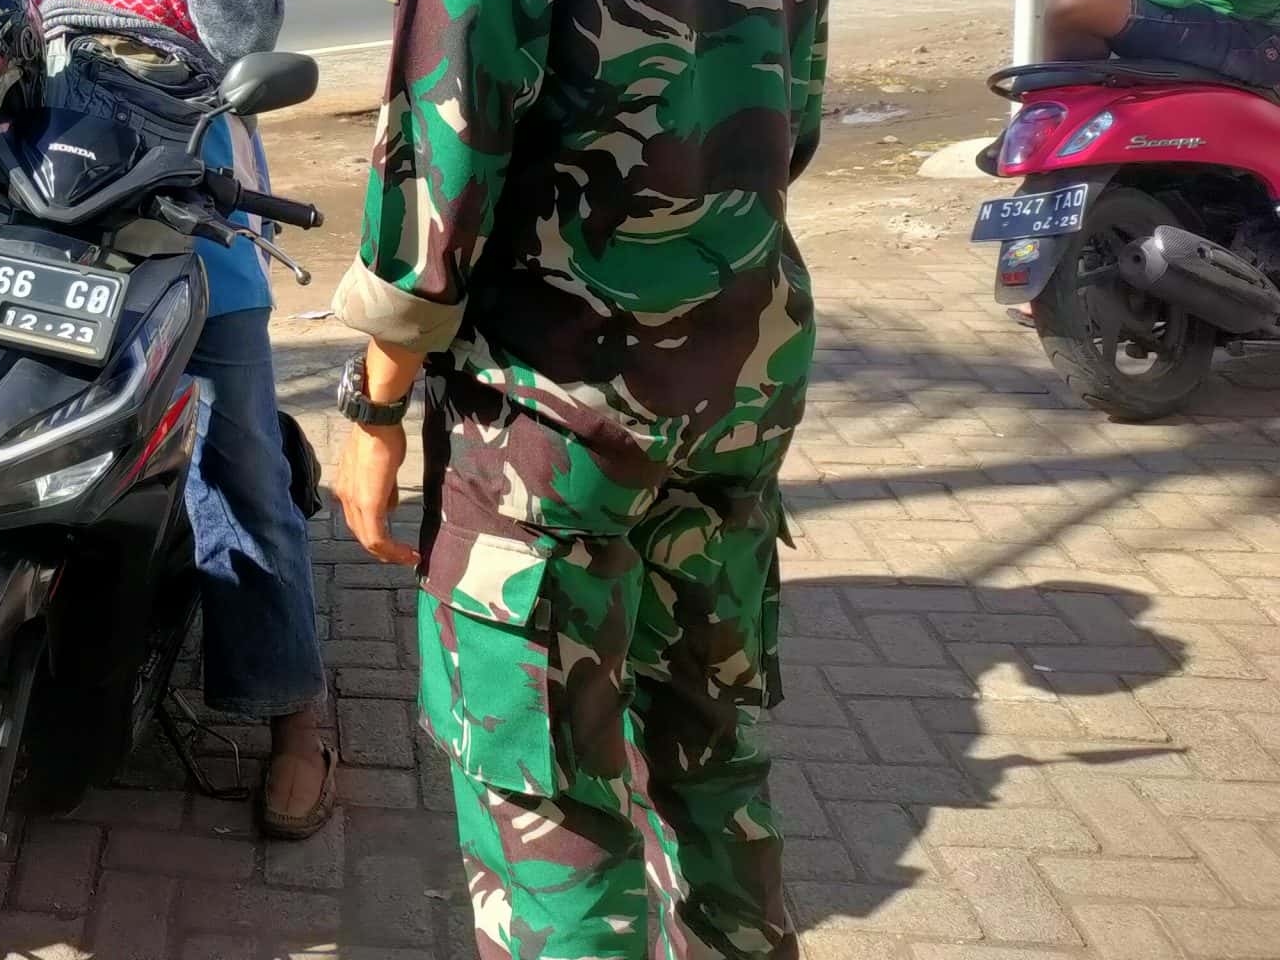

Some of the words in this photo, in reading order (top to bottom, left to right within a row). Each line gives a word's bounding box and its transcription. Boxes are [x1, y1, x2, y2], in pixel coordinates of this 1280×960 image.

[1124, 134, 1206, 149] Scoopy
[48, 143, 97, 161] HONDA
[980, 203, 993, 221] N
[1000, 198, 1045, 218] 5347
